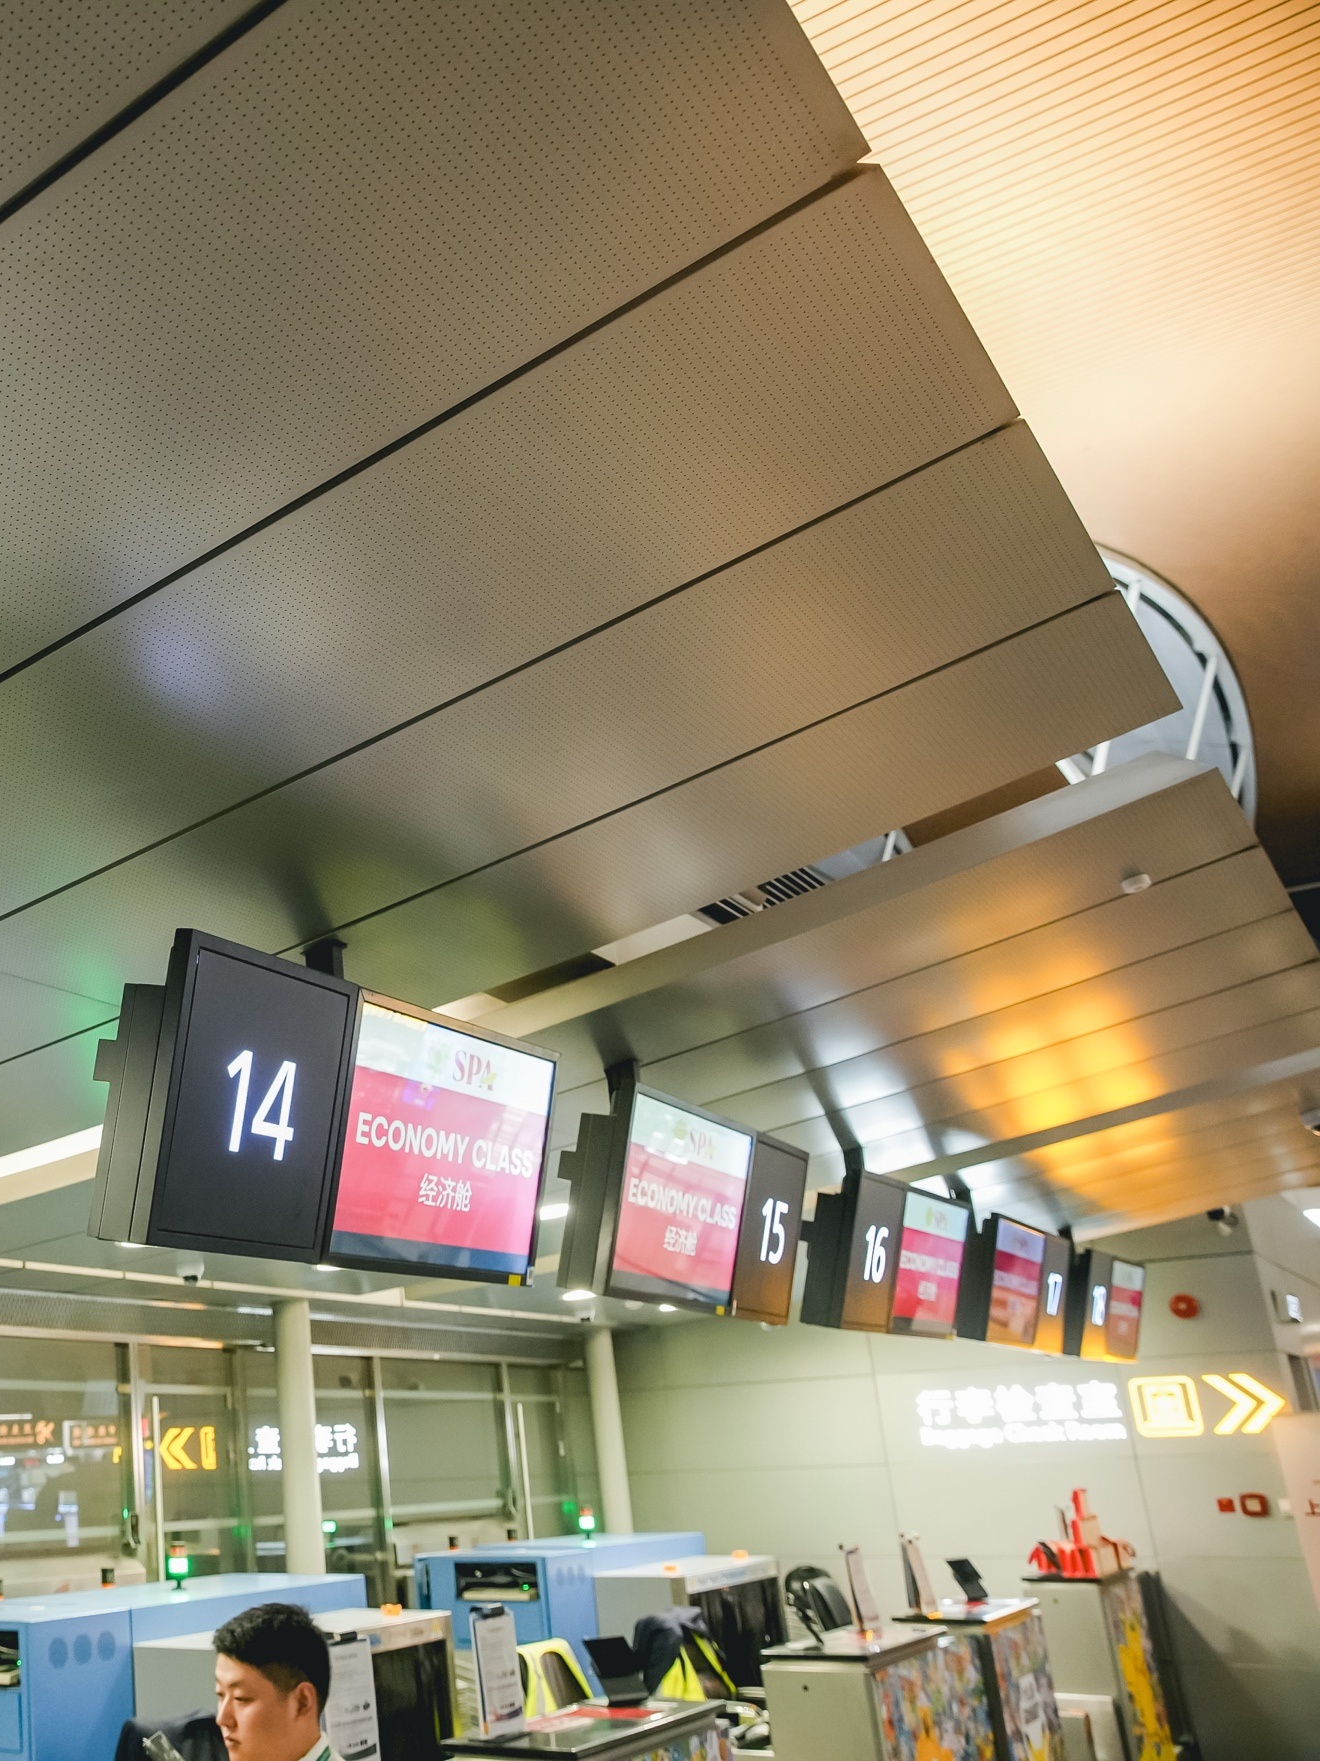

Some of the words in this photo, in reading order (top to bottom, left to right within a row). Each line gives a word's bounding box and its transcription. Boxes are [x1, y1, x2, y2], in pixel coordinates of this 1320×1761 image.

[452, 1050, 495, 1092] SPA
[227, 1049, 296, 1161] 14
[355, 1111, 470, 1164] ECONOMY
[471, 1138, 535, 1178] CLASS
[417, 1172, 473, 1212] 经济舱
[628, 1177, 697, 1218] ECONOMY
[697, 1198, 737, 1230] CLASS
[760, 1198, 789, 1264] 15
[863, 1224, 889, 1284] 16
